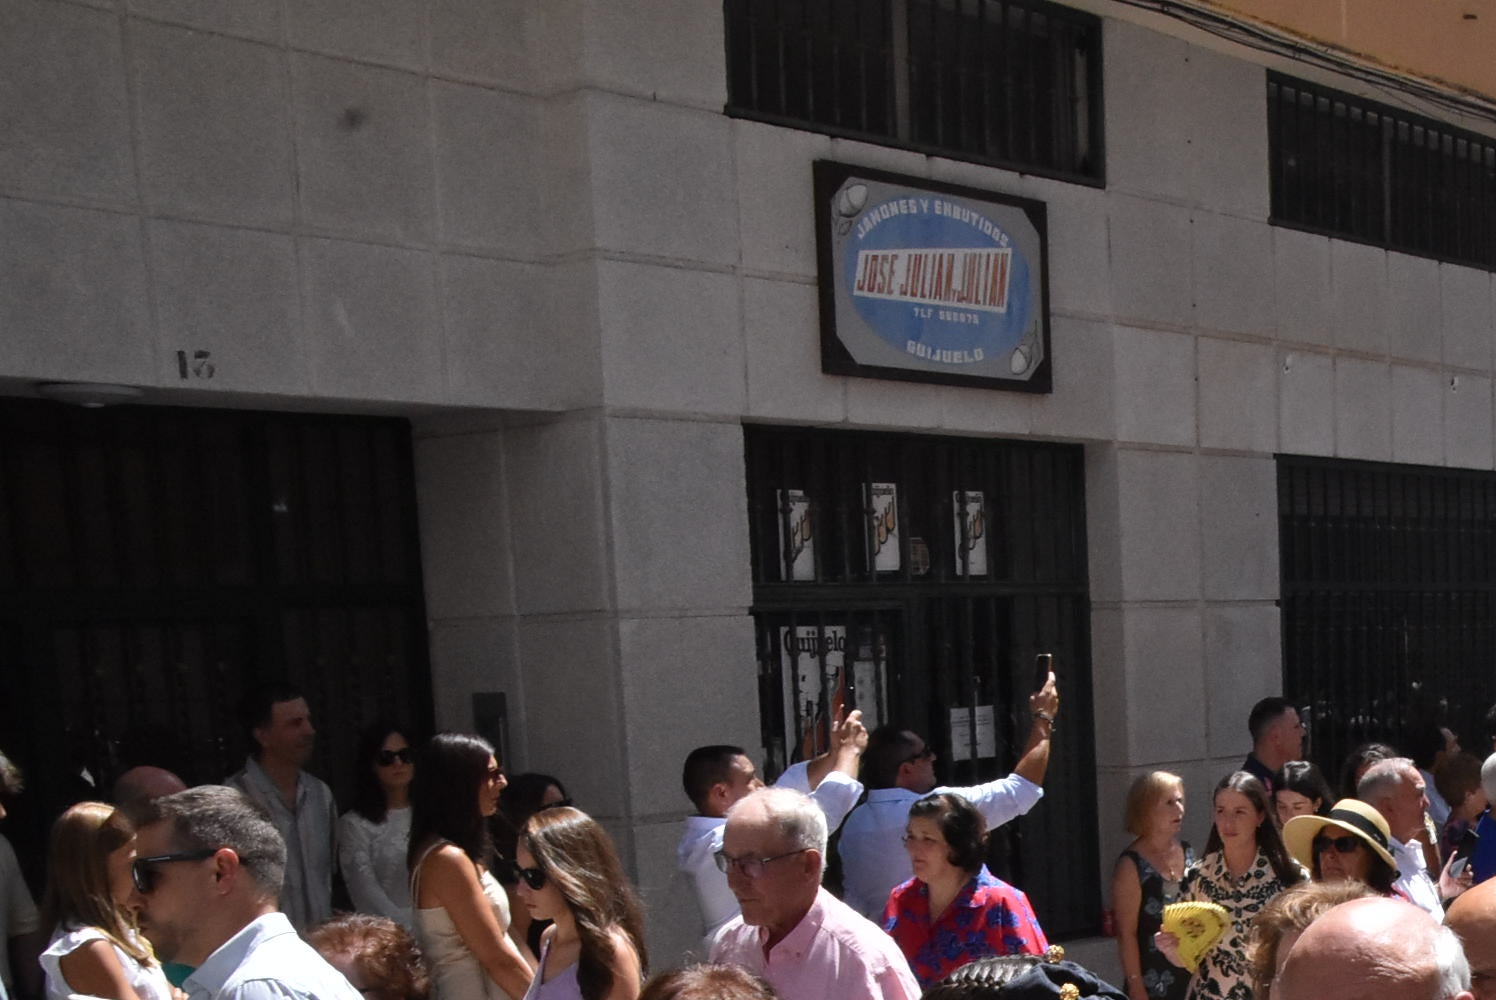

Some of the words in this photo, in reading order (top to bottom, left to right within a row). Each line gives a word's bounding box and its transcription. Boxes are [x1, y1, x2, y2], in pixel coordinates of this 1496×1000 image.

[857, 199, 918, 240] JAMONES
[919, 199, 928, 214] Y
[933, 200, 1009, 248] EMBUTIDOS
[857, 253, 898, 295] JOSE
[899, 253, 955, 301] JULIAN
[906, 340, 985, 363] GUIJUELO
